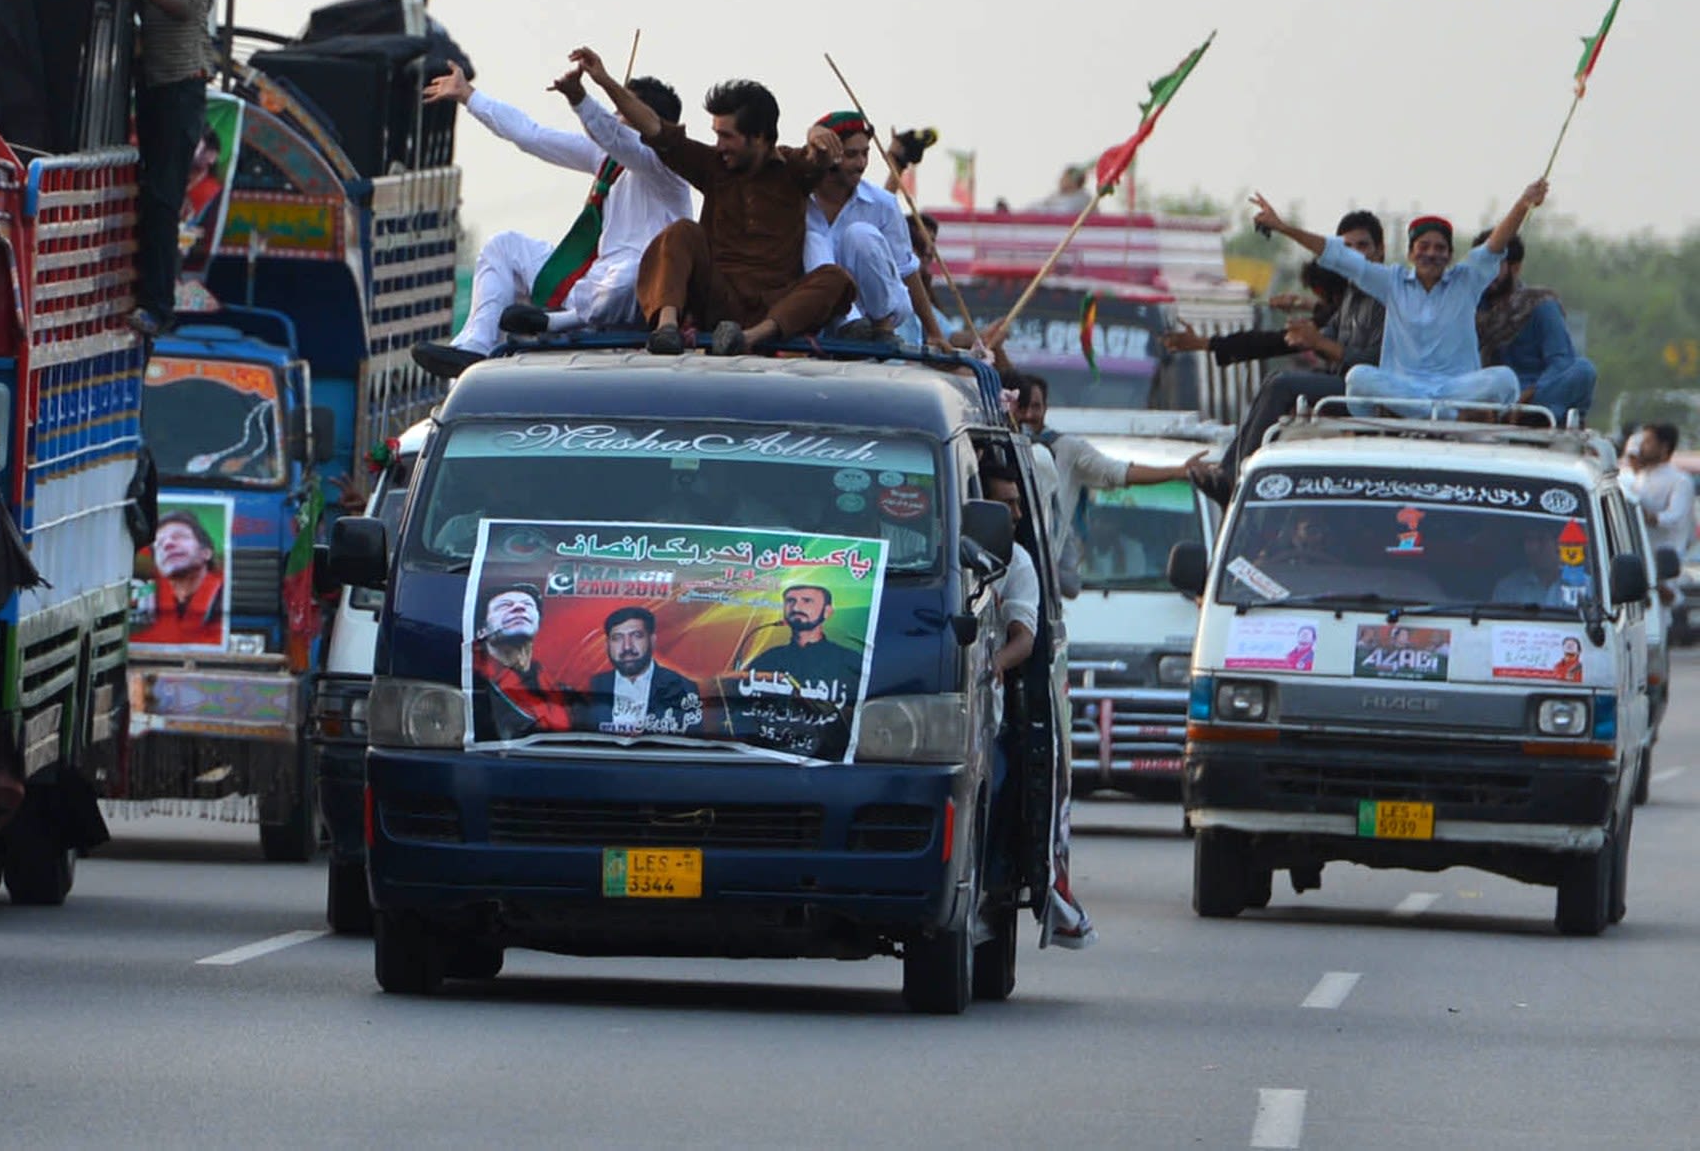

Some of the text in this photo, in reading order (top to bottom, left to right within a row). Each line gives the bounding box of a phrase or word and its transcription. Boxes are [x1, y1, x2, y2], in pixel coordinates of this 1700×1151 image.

[502, 422, 878, 463] Masha Allah
[556, 534, 873, 580] پاکستان تحریک انصاف
[633, 854, 669, 872] LES
